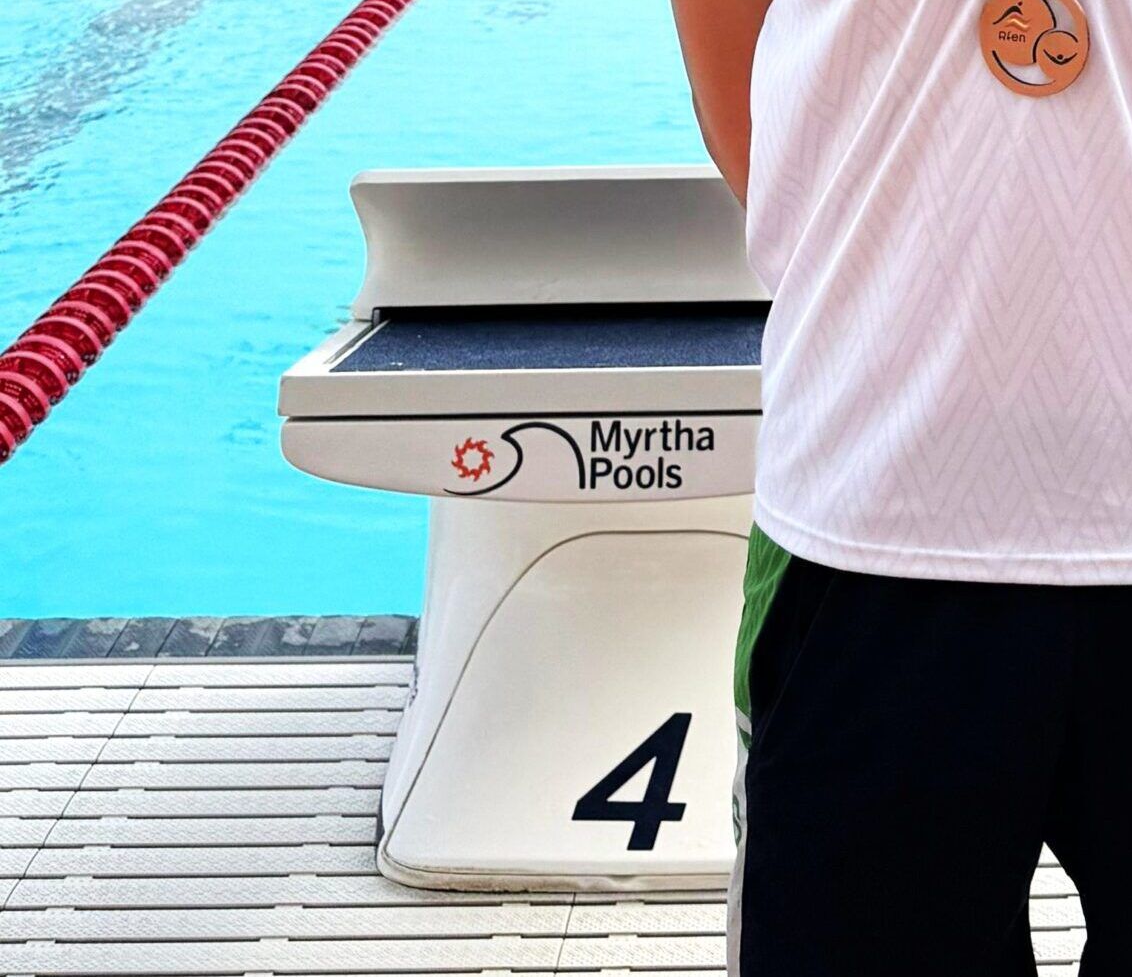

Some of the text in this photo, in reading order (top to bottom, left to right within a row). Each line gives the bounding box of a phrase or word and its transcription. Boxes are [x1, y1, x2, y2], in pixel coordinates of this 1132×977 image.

[590, 419, 715, 459] Myrtha
[589, 456, 683, 489] Pools
[571, 712, 692, 851] 4
